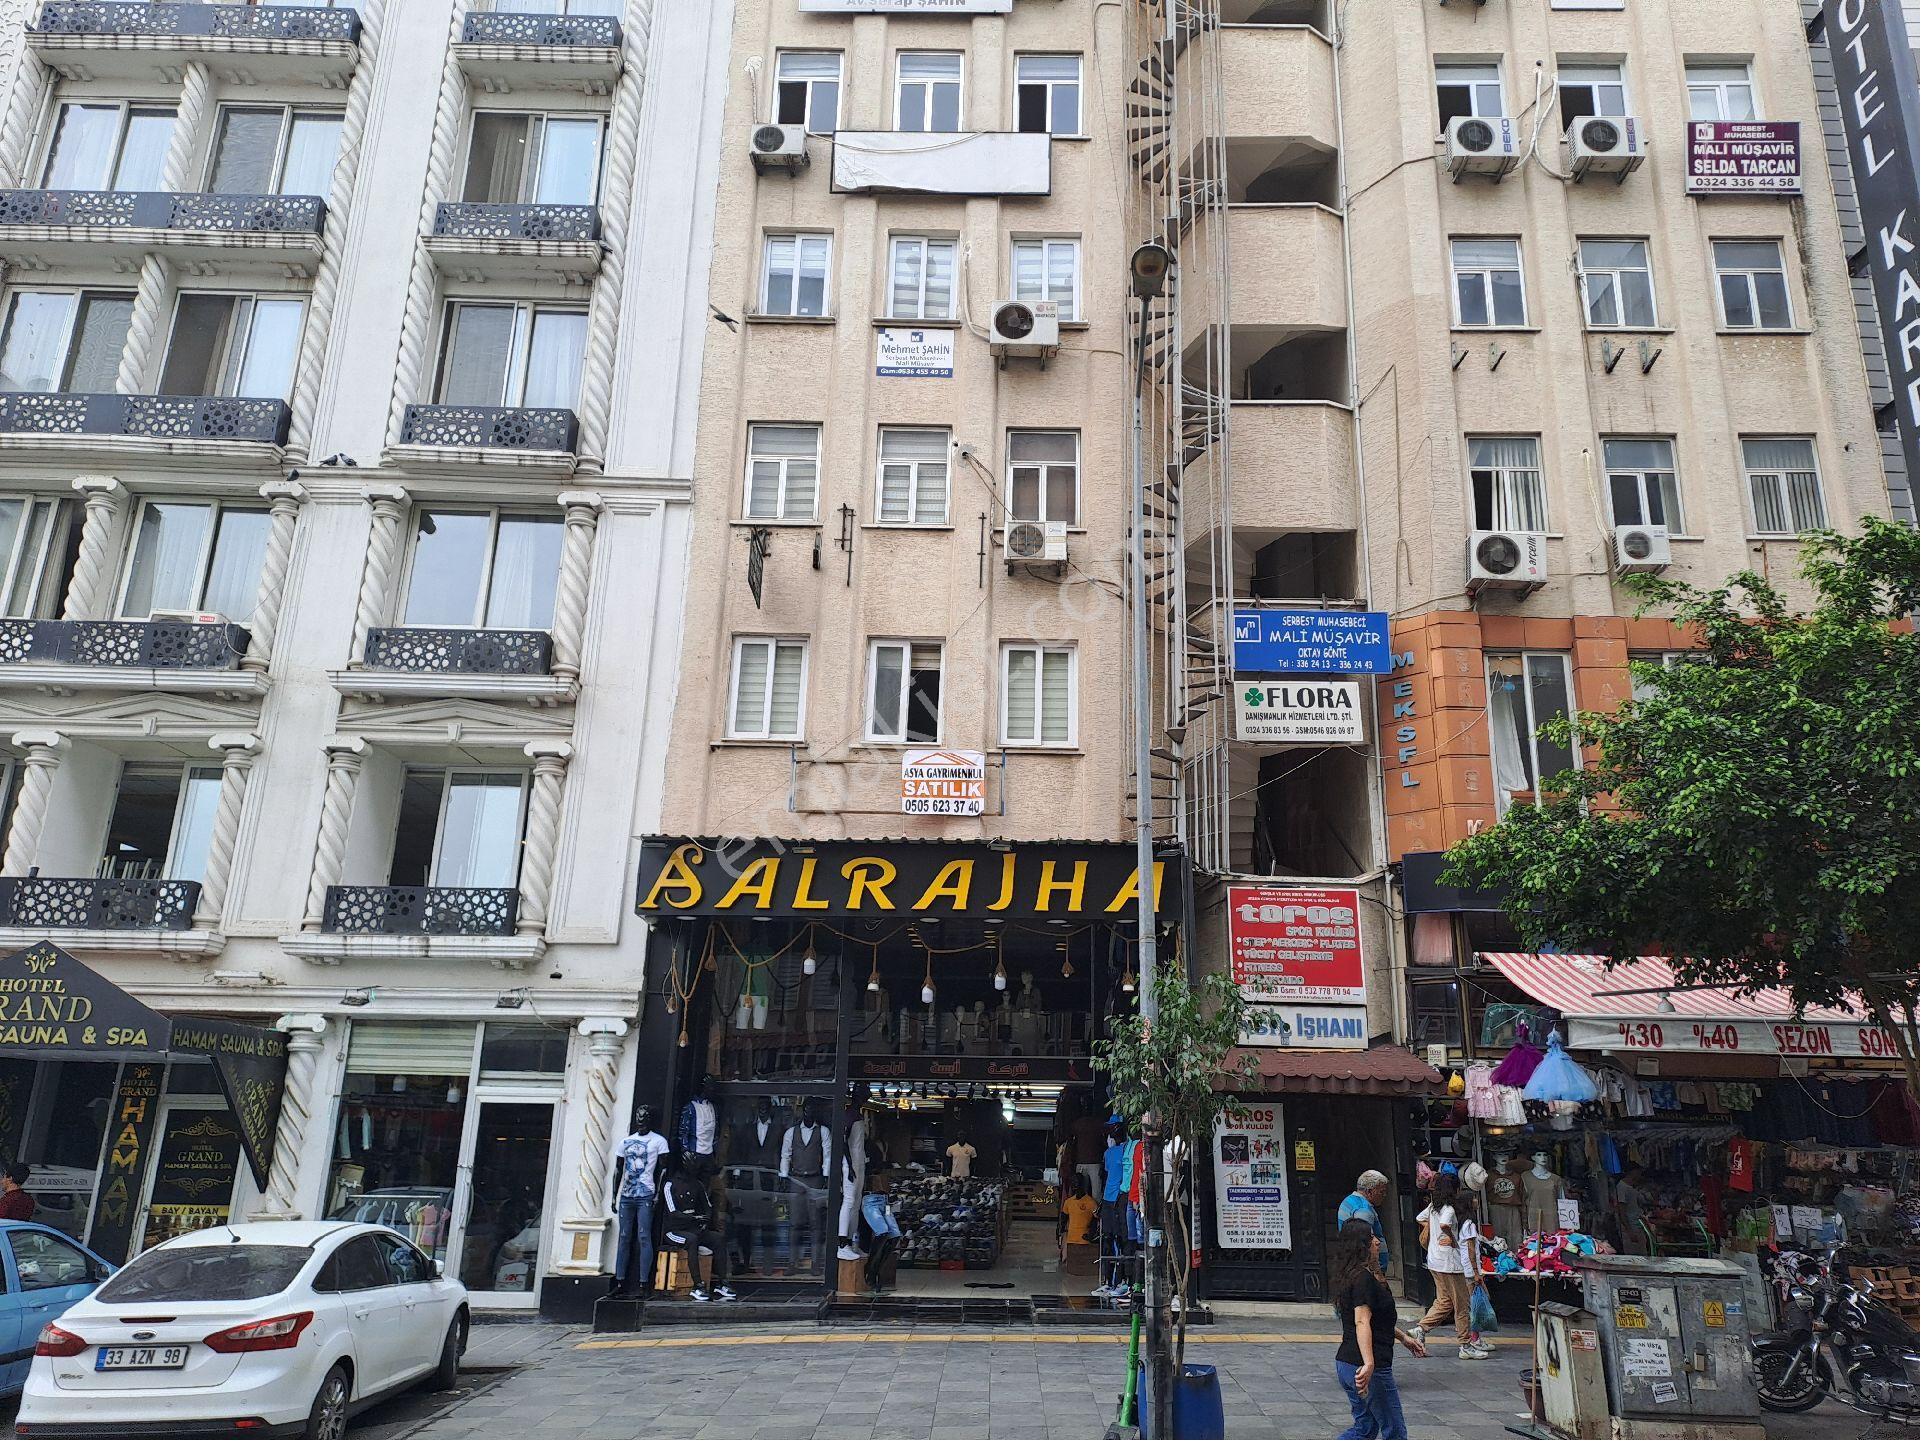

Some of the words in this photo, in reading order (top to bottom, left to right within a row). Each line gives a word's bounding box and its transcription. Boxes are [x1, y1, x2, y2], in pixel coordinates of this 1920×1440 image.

[1501, 118, 1512, 153] BEKO
[1694, 143, 1728, 155] MALİ
[1732, 143, 1795, 157] MÜŞAVİR
[1694, 159, 1738, 174] SELDA
[1741, 159, 1796, 174] TARCAN
[1696, 178, 1727, 186] 0324
[1731, 178, 1754, 186] 336
[1759, 178, 1775, 186] 44
[1779, 178, 1794, 186] 58
[881, 344, 920, 354] Mehmet
[922, 343, 950, 356] ŞAHİN
[1282, 616, 1315, 627] SERBEST
[1317, 616, 1367, 628] MUHASEBECİ
[1269, 629, 1308, 643] MALİ
[1311, 629, 1381, 646] MÜŞAVİR
[1298, 648, 1321, 659] OKTAY
[1296, 659, 1309, 668] 336
[1311, 660, 1320, 668] 24
[1321, 660, 1331, 668] 13
[1339, 660, 1352, 669] 336
[1354, 661, 1363, 669] 24
[1364, 661, 1373, 669] 43
[1266, 687, 1352, 708] FLORA
[1245, 712, 1287, 722] DANIŞMANLIK
[1288, 711, 1325, 720] HİZMETLERİ
[1245, 726, 1260, 734] 0324
[904, 768, 924, 778] ASYA
[927, 767, 983, 779] GAYRİMENKUL
[904, 781, 982, 797] SATILIK
[905, 799, 930, 812] 0505
[932, 799, 950, 812] 623
[953, 801, 965, 813] 37
[968, 801, 980, 813] 40
[1286, 926, 1313, 937] SPOR
[1315, 925, 1356, 938] KULÜBÜ
[0, 979, 66, 993] HOTEL
[82, 1026, 97, 1044] &
[105, 1027, 148, 1046] SPA
[173, 1029, 218, 1050] HAMAM
[221, 1034, 255, 1054] SAUNA
[257, 1039, 264, 1056] &
[266, 1040, 285, 1057] SPA
[1618, 1023, 1663, 1049] %30
[1693, 1024, 1739, 1050] %40
[1773, 1026, 1833, 1054] SEZON
[120, 1087, 157, 1096] GRAND
[100, 1098, 147, 1229] HAMAM
[178, 1152, 223, 1162] GRAND
[189, 1207, 219, 1215] BAYAN
[106, 1350, 123, 1365] 33
[129, 1350, 156, 1365] AZN
[163, 1349, 181, 1364] 98
